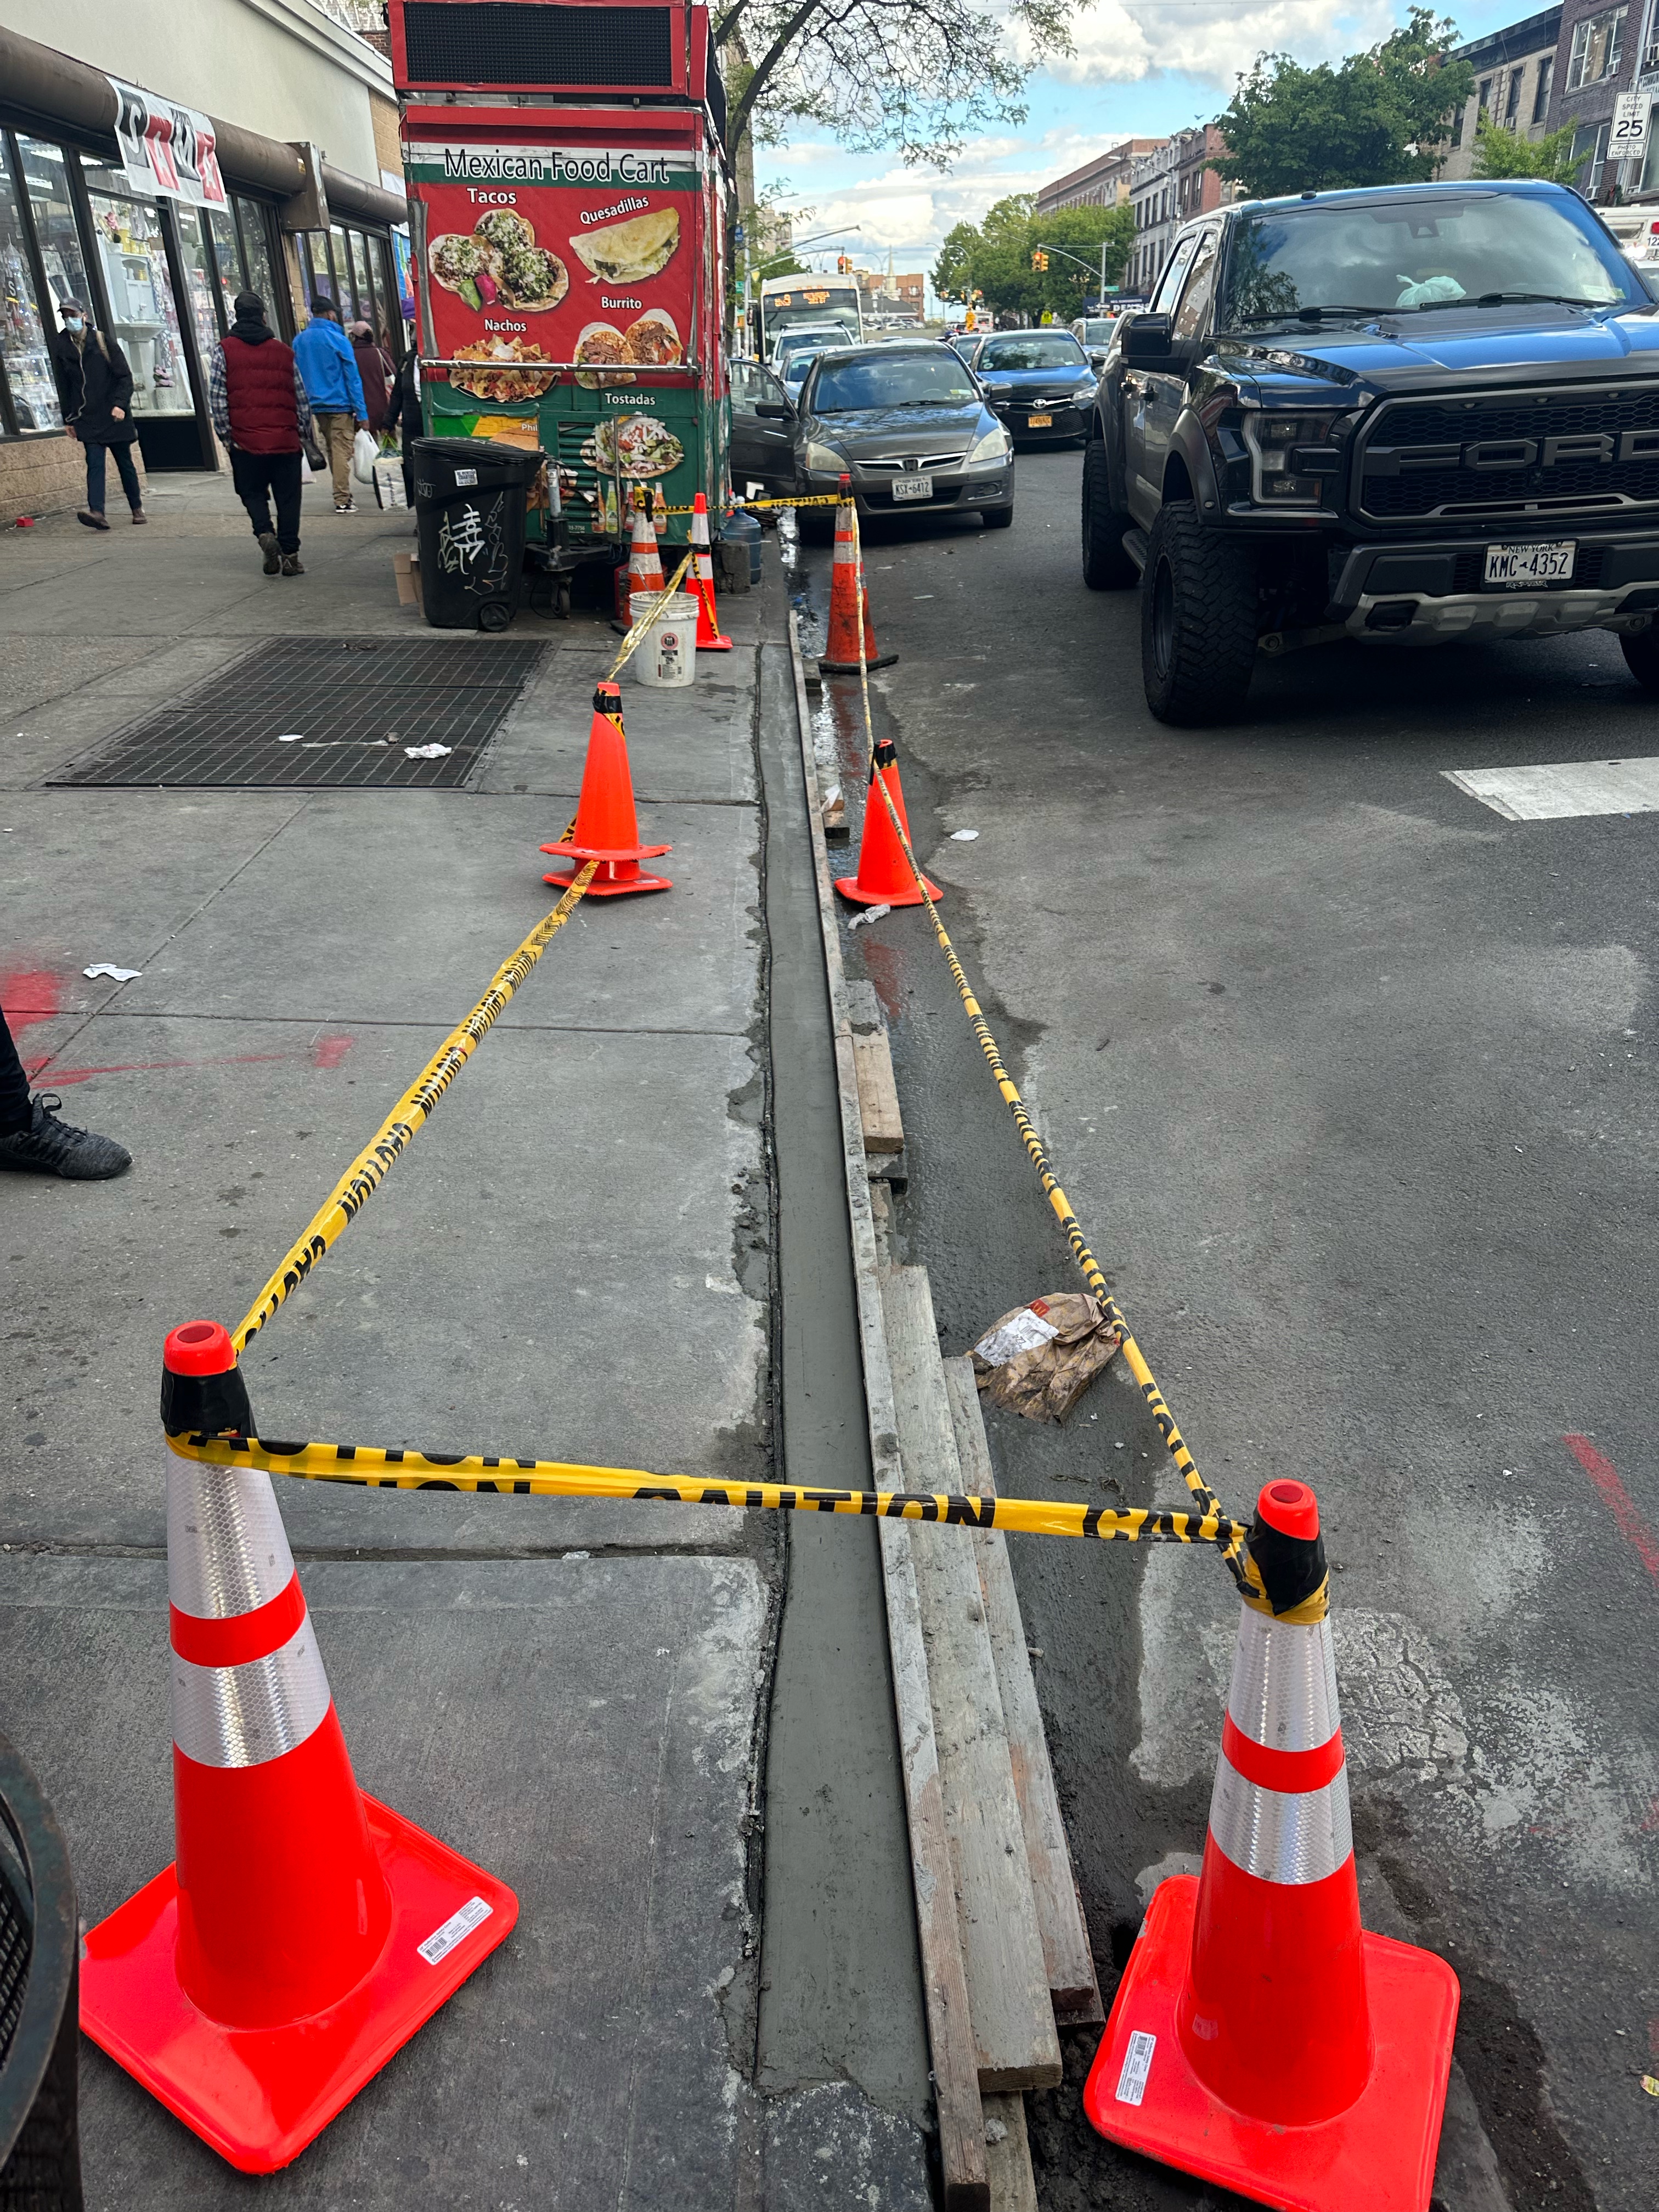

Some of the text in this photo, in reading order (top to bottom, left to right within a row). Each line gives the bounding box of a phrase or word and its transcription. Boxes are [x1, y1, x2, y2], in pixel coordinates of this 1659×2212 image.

[1616, 120, 1643, 138] 25
[445, 148, 669, 184] Mexican Food Cart
[467, 188, 517, 205] Tacos
[579, 195, 650, 225] Quesadillas
[601, 296, 642, 311] Burrito
[484, 318, 527, 333] Nachos
[605, 392, 656, 407] Tostadas
[1509, 544, 1554, 554] NEW YORK
